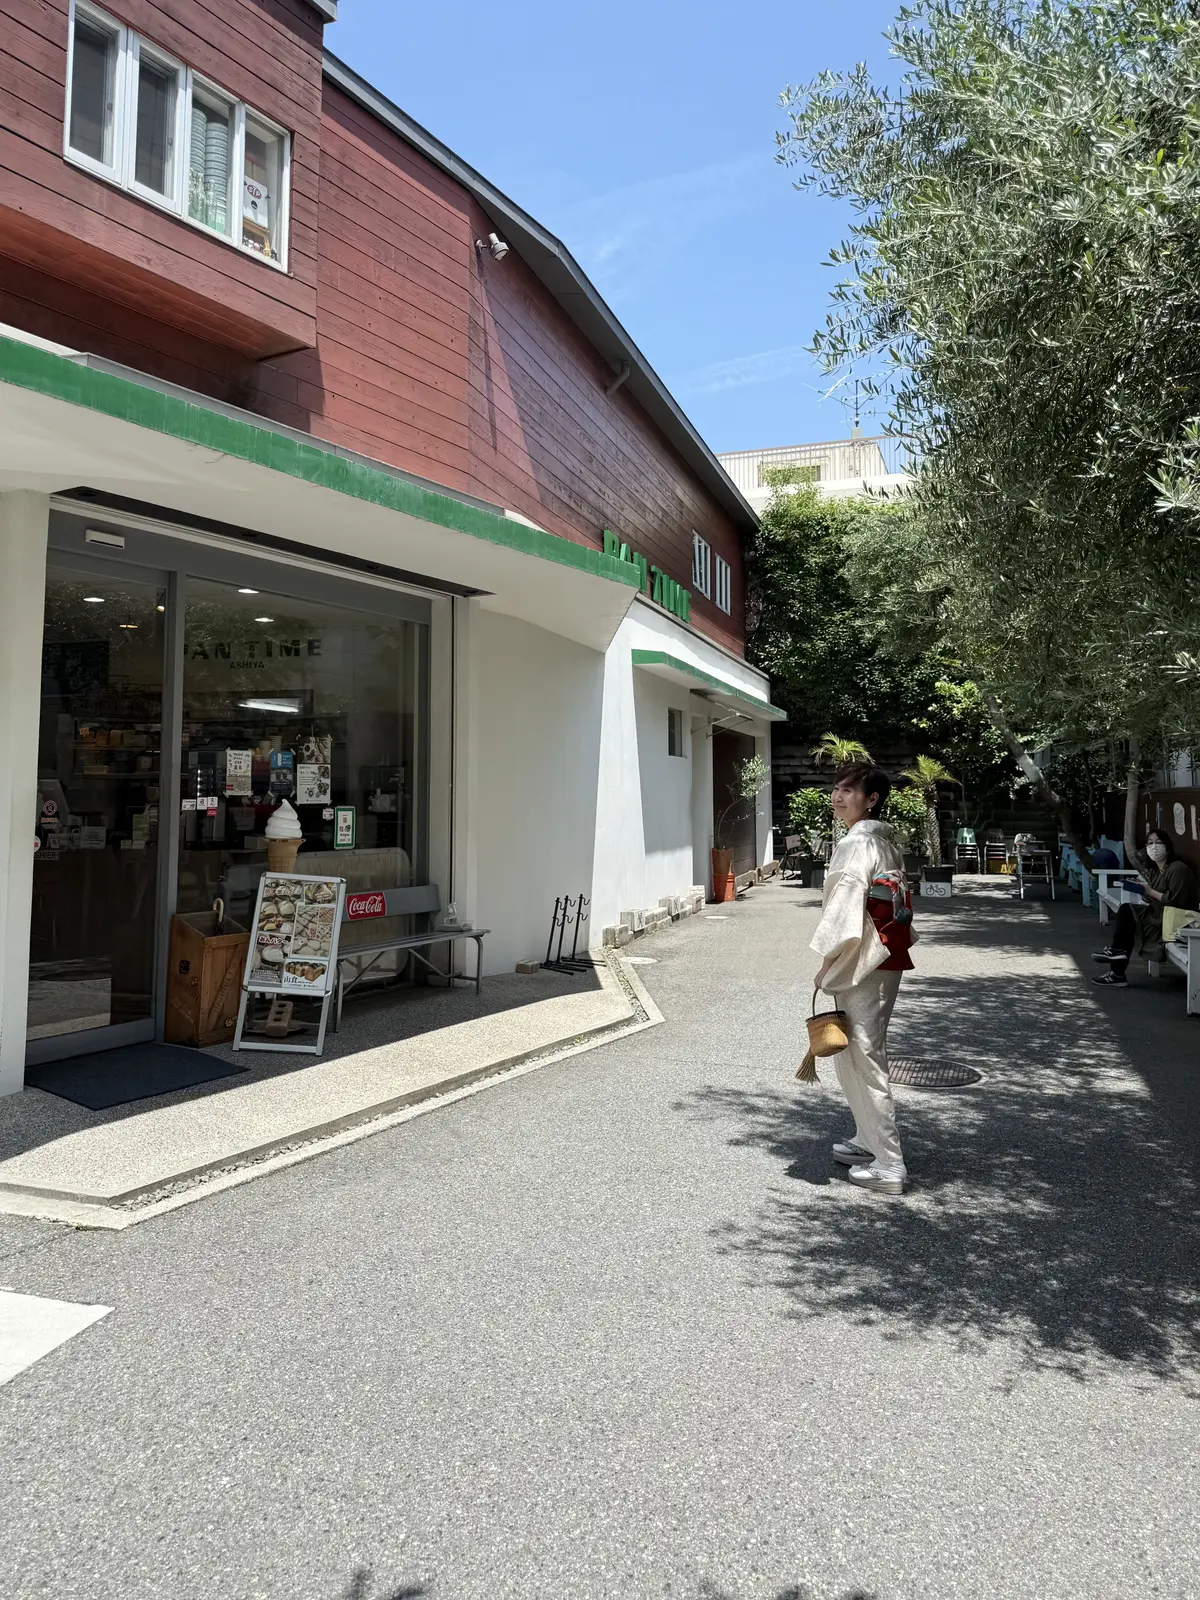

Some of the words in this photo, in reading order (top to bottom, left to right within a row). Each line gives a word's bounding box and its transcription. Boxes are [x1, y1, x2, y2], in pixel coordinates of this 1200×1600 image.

[248, 186, 261, 198] STP
[244, 638, 322, 658] TIME
[229, 661, 265, 670] ASHIYA
